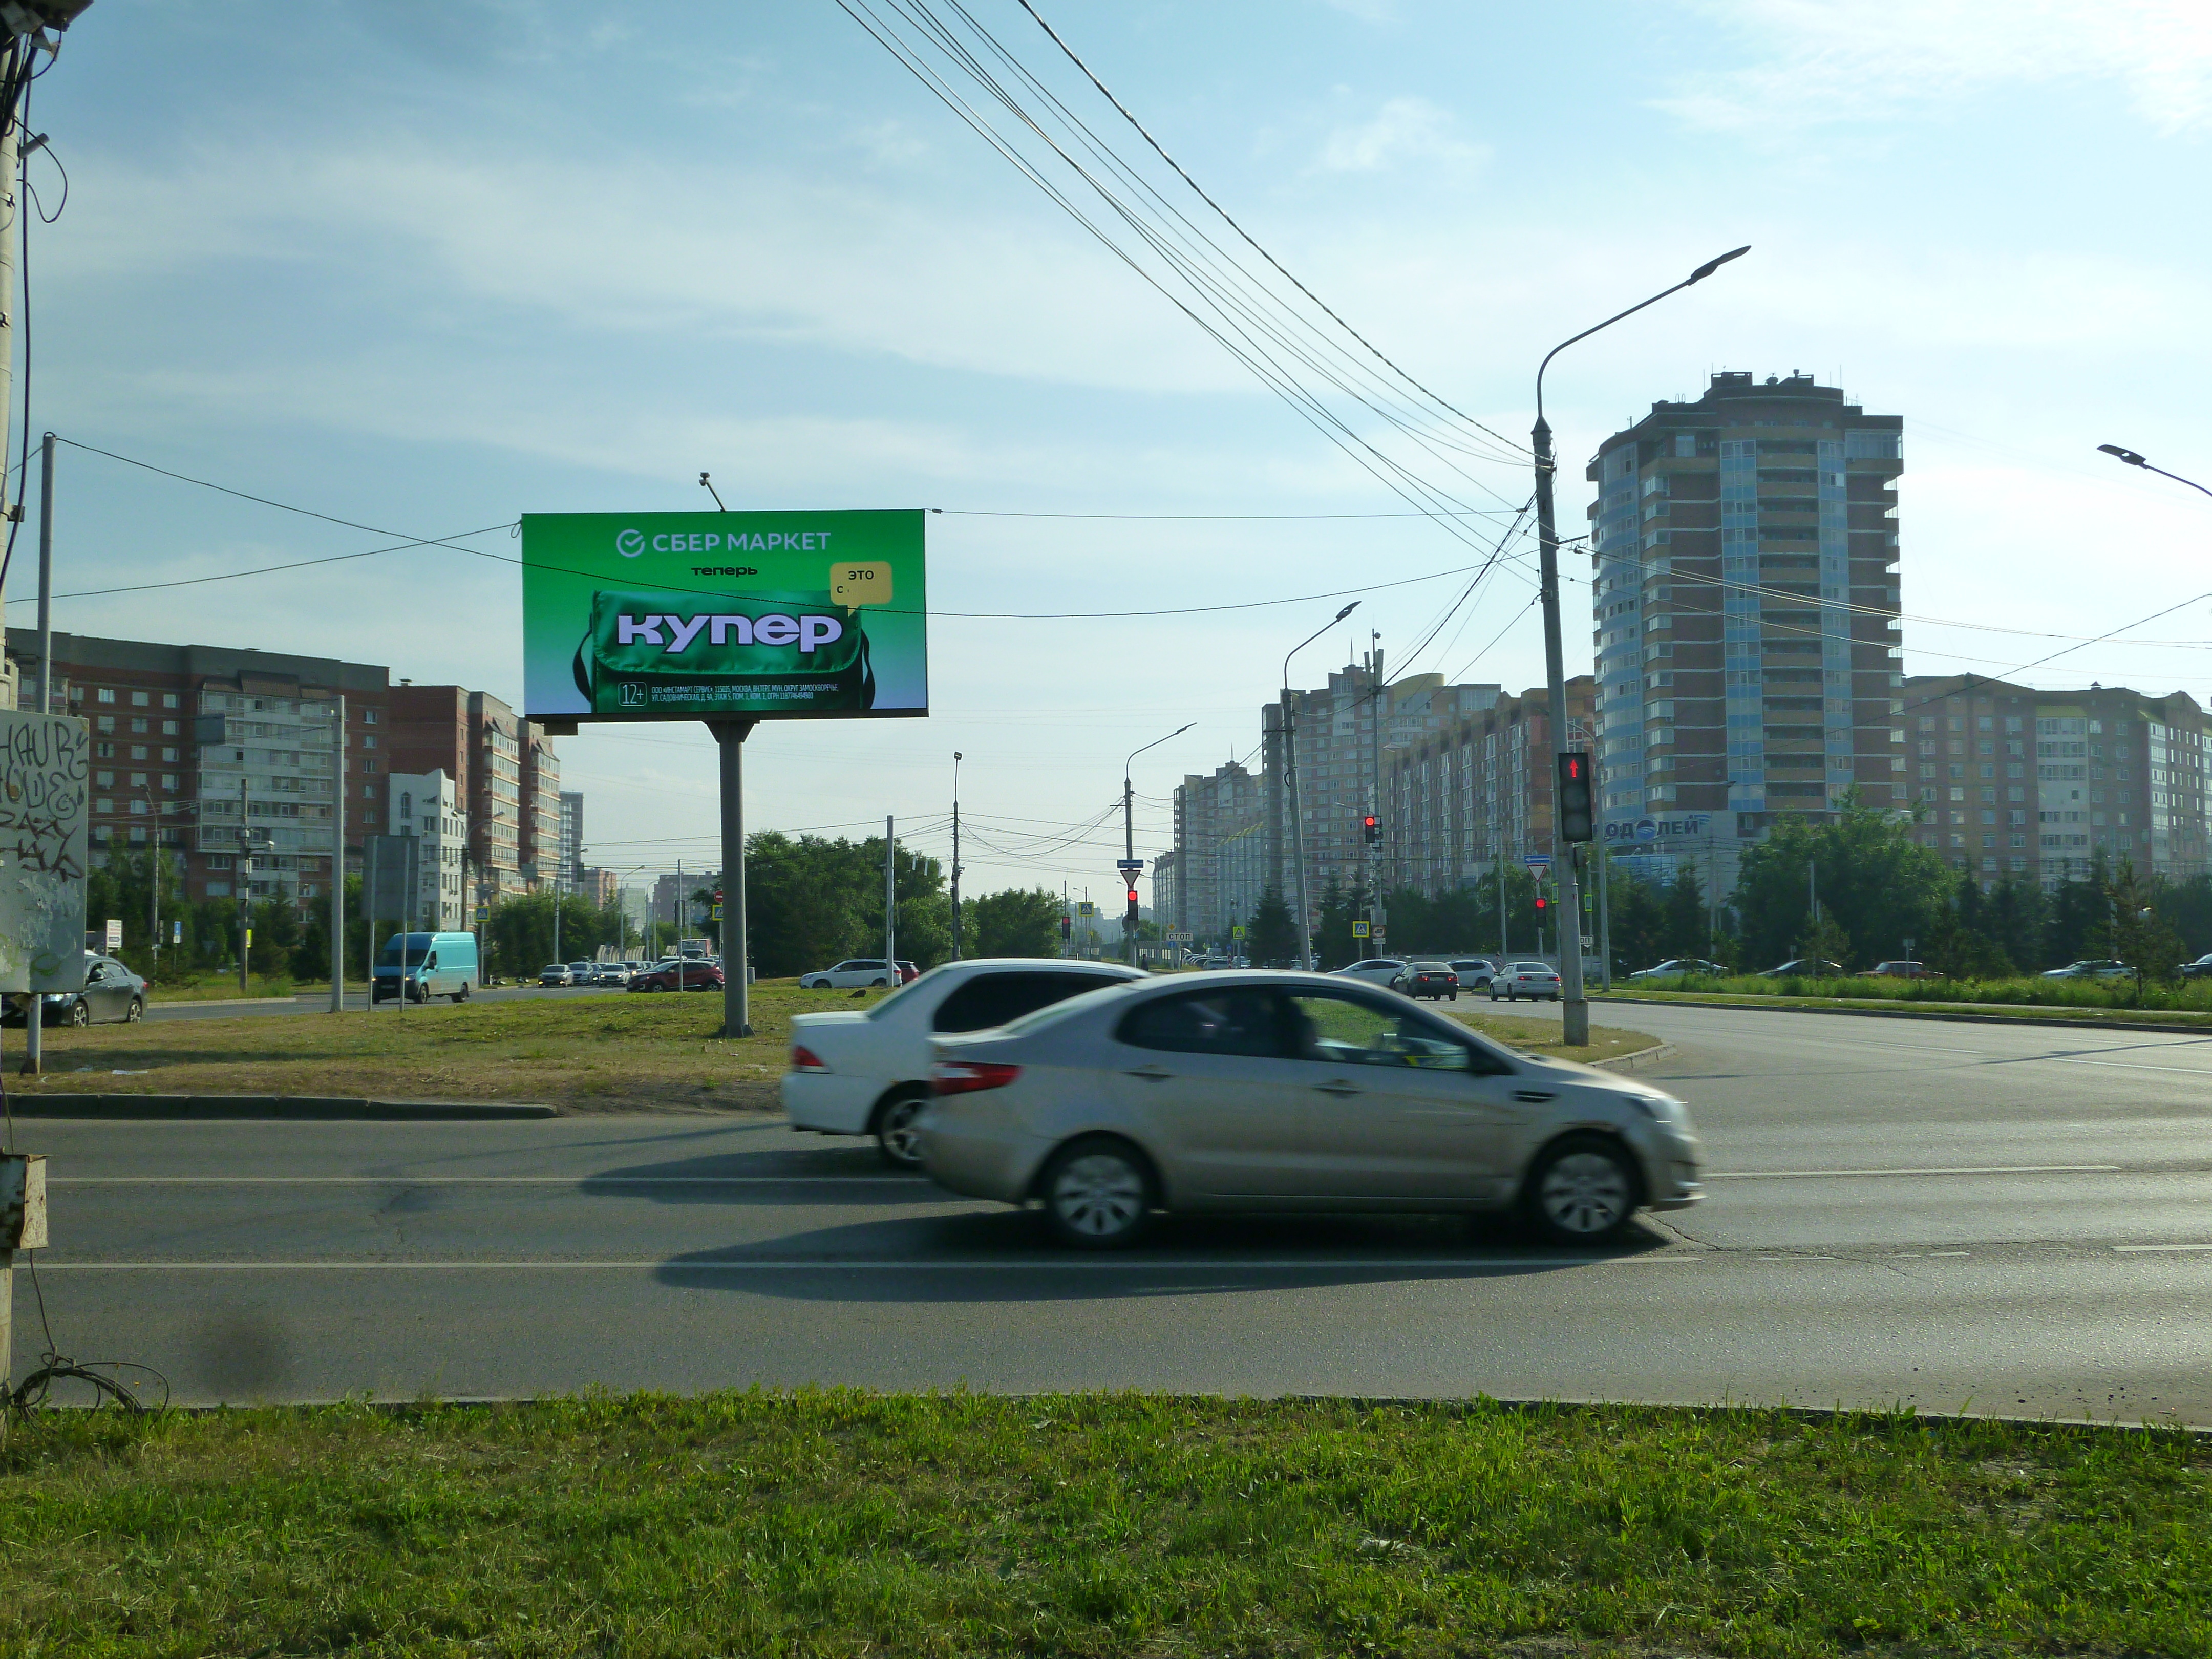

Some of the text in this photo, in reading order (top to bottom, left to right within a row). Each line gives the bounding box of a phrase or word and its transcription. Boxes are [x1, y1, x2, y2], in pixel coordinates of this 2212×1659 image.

[653, 533, 831, 551] СБЕР МАРКЕТ
[691, 567, 758, 578] теперь
[848, 570, 874, 580] ЭТО
[618, 614, 842, 653] купер
[622, 684, 644, 704] 12+
